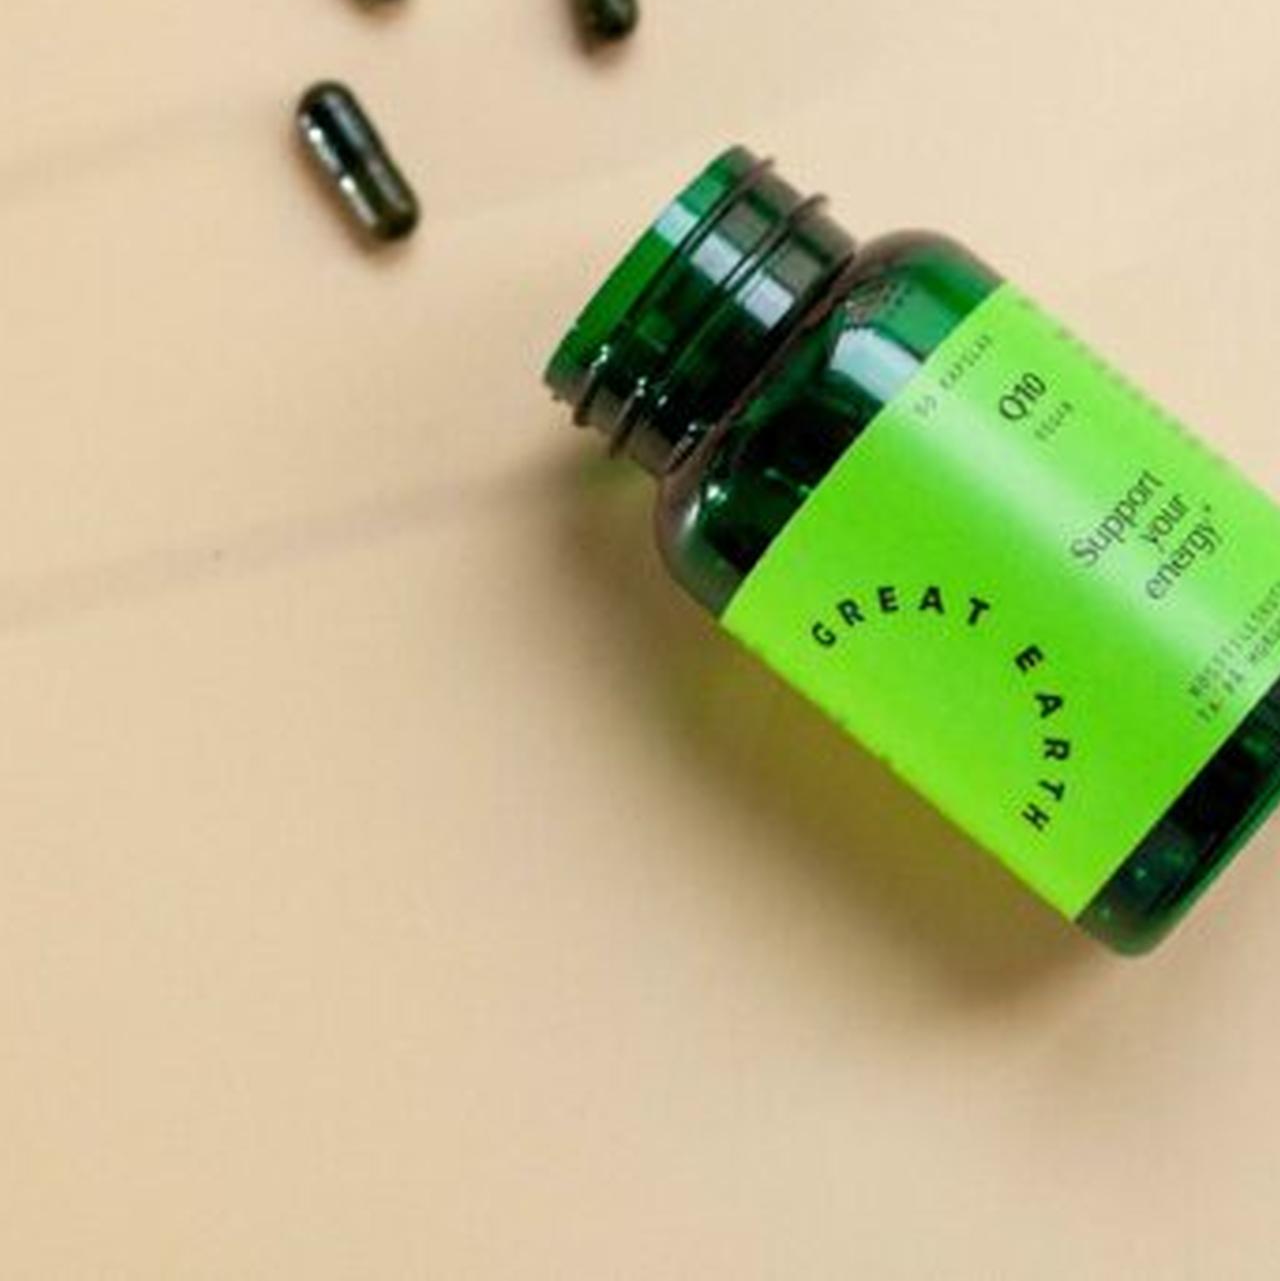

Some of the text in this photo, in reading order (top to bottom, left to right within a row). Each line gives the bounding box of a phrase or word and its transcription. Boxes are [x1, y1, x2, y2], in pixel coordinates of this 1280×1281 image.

[998, 371, 1047, 421] Q10
[1070, 470, 1164, 567] Support
[1138, 493, 1190, 554] your
[810, 585, 1071, 832] GREAT EARTH
